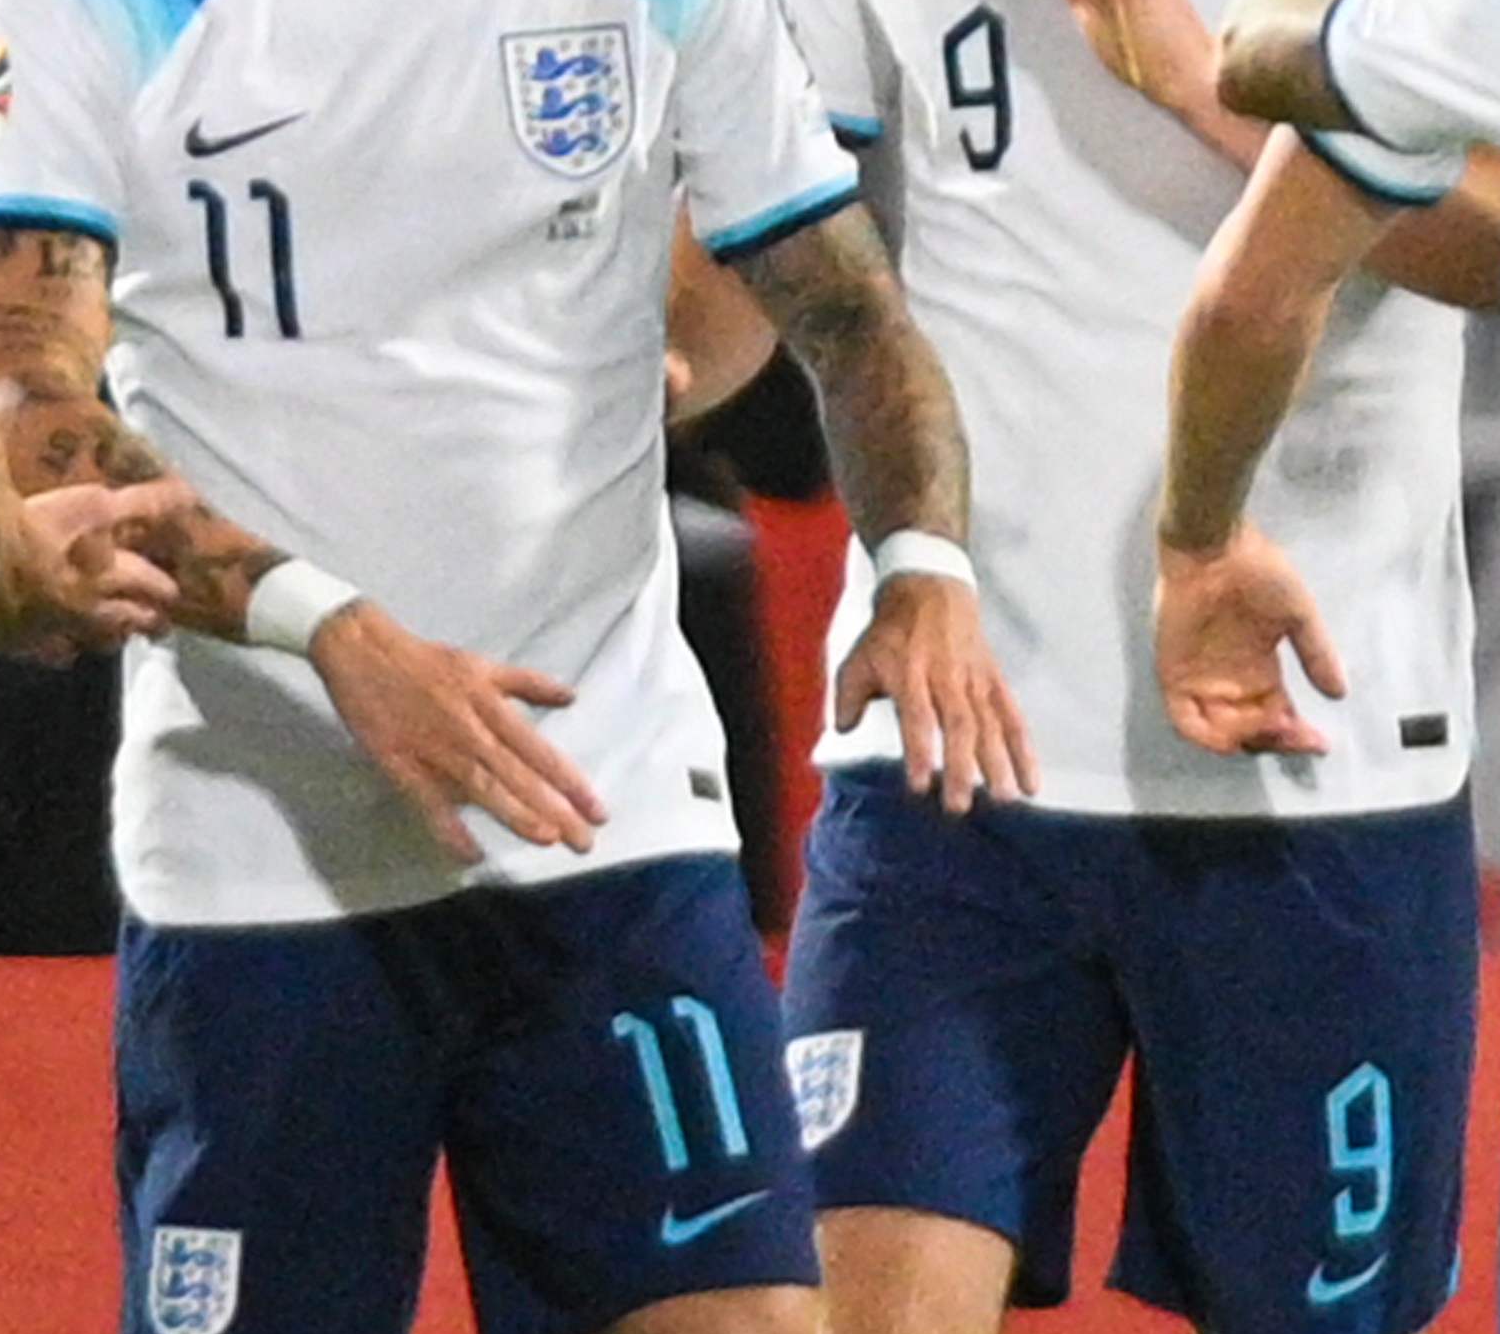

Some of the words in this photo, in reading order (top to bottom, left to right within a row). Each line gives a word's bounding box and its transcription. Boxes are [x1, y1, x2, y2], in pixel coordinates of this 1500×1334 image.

[942, 3, 1012, 171] 9
[187, 179, 302, 339] 11
[613, 994, 748, 1172] 11
[1327, 1061, 1395, 1237] 9
